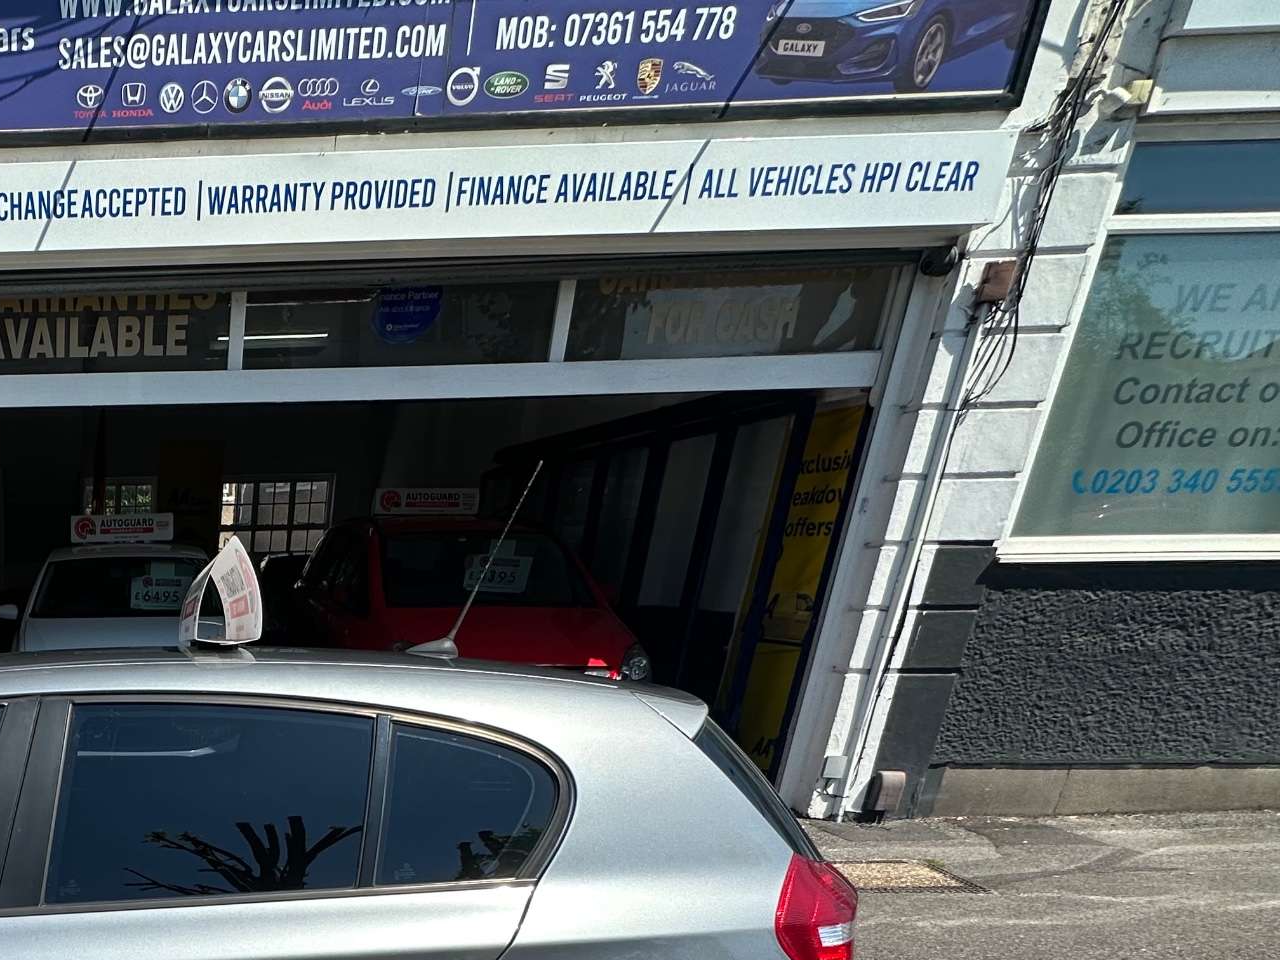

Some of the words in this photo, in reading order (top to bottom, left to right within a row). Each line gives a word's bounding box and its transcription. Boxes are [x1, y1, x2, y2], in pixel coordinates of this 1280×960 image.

[496, 15, 557, 51] MOB:
[563, 10, 640, 47] 07361
[641, 7, 690, 44] 554
[691, 6, 737, 42] 778
[58, 24, 447, 70] SALES@GALAXYCARSLIMITED.COM
[783, 42, 819, 53] GALAXY
[493, 77, 517, 86] LAND
[664, 79, 717, 93] JAGUAR
[493, 84, 522, 94] ROVER
[261, 91, 293, 99] NISSAN
[579, 93, 628, 102] PEUGEOT
[302, 100, 332, 111] Audi
[343, 96, 395, 106] LEXUS
[111, 109, 154, 118] HONDA
[81, 187, 186, 219] ACCEPTED
[207, 181, 326, 215] WARRANTY
[330, 178, 436, 211] PROVIDED
[456, 174, 553, 206] FINANCE
[555, 169, 677, 203] AVAILABLE
[698, 167, 739, 199] ALL
[748, 164, 853, 197] VEHICLES
[858, 162, 901, 193] HPI
[906, 160, 979, 193] CLEAR
[1174, 284, 1237, 313] WE
[1113, 376, 1250, 406] Contact
[1115, 420, 1217, 449] Office
[1090, 468, 1160, 495] 0203
[1167, 467, 1220, 494] 340
[405, 492, 461, 501] AUTOGUARD
[100, 518, 155, 528] AUTOGUARD
[784, 516, 834, 537] offers
